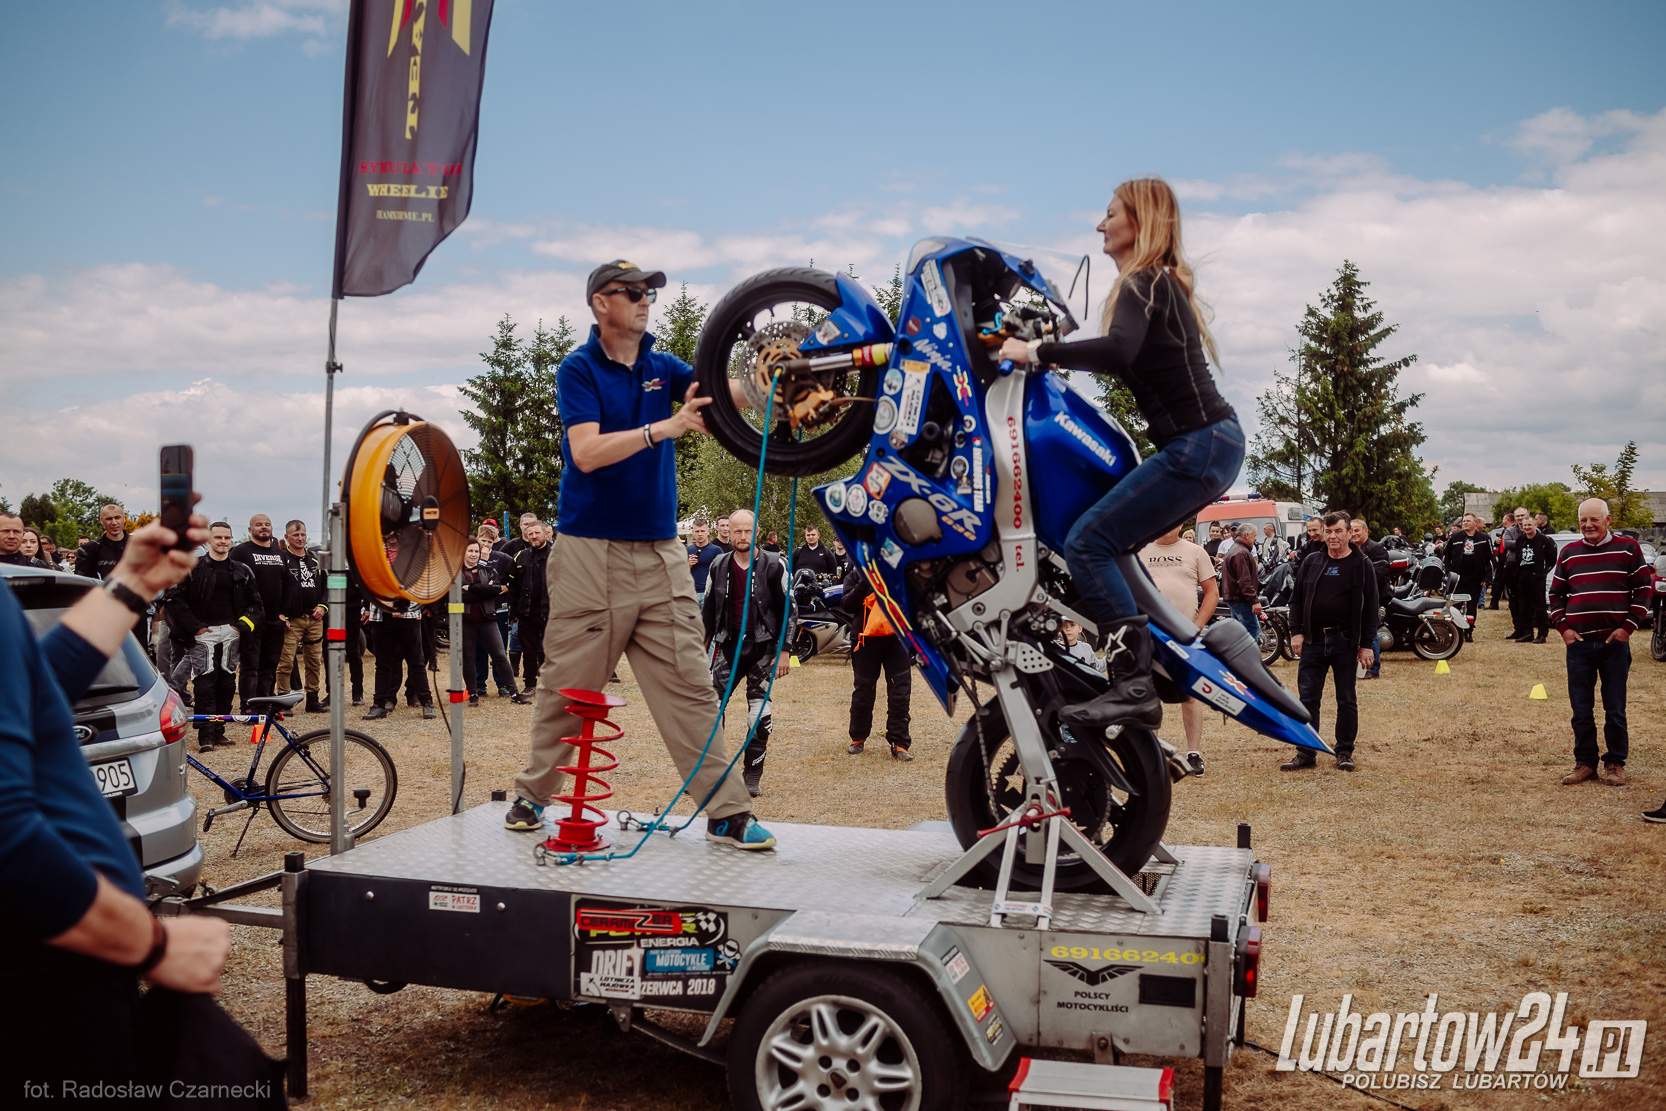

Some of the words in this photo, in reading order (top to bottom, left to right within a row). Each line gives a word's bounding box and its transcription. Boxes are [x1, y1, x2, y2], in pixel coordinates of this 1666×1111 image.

[404, 0, 428, 139] TEA
[913, 339, 952, 372] Ninja
[1054, 410, 1117, 467] Kawasaki
[1007, 416, 1023, 529] 691662400
[880, 455, 983, 534] ZX-6R
[96, 763, 131, 792] 905
[640, 937, 699, 948] ENERGIA
[655, 953, 708, 966] MOTOCYKLE
[1051, 945, 1205, 965] 69166240
[687, 978, 716, 996] 2018
[1074, 990, 1111, 1001] POLSCY
[1056, 1001, 1130, 1014] MOTOCYKLIŚCI
